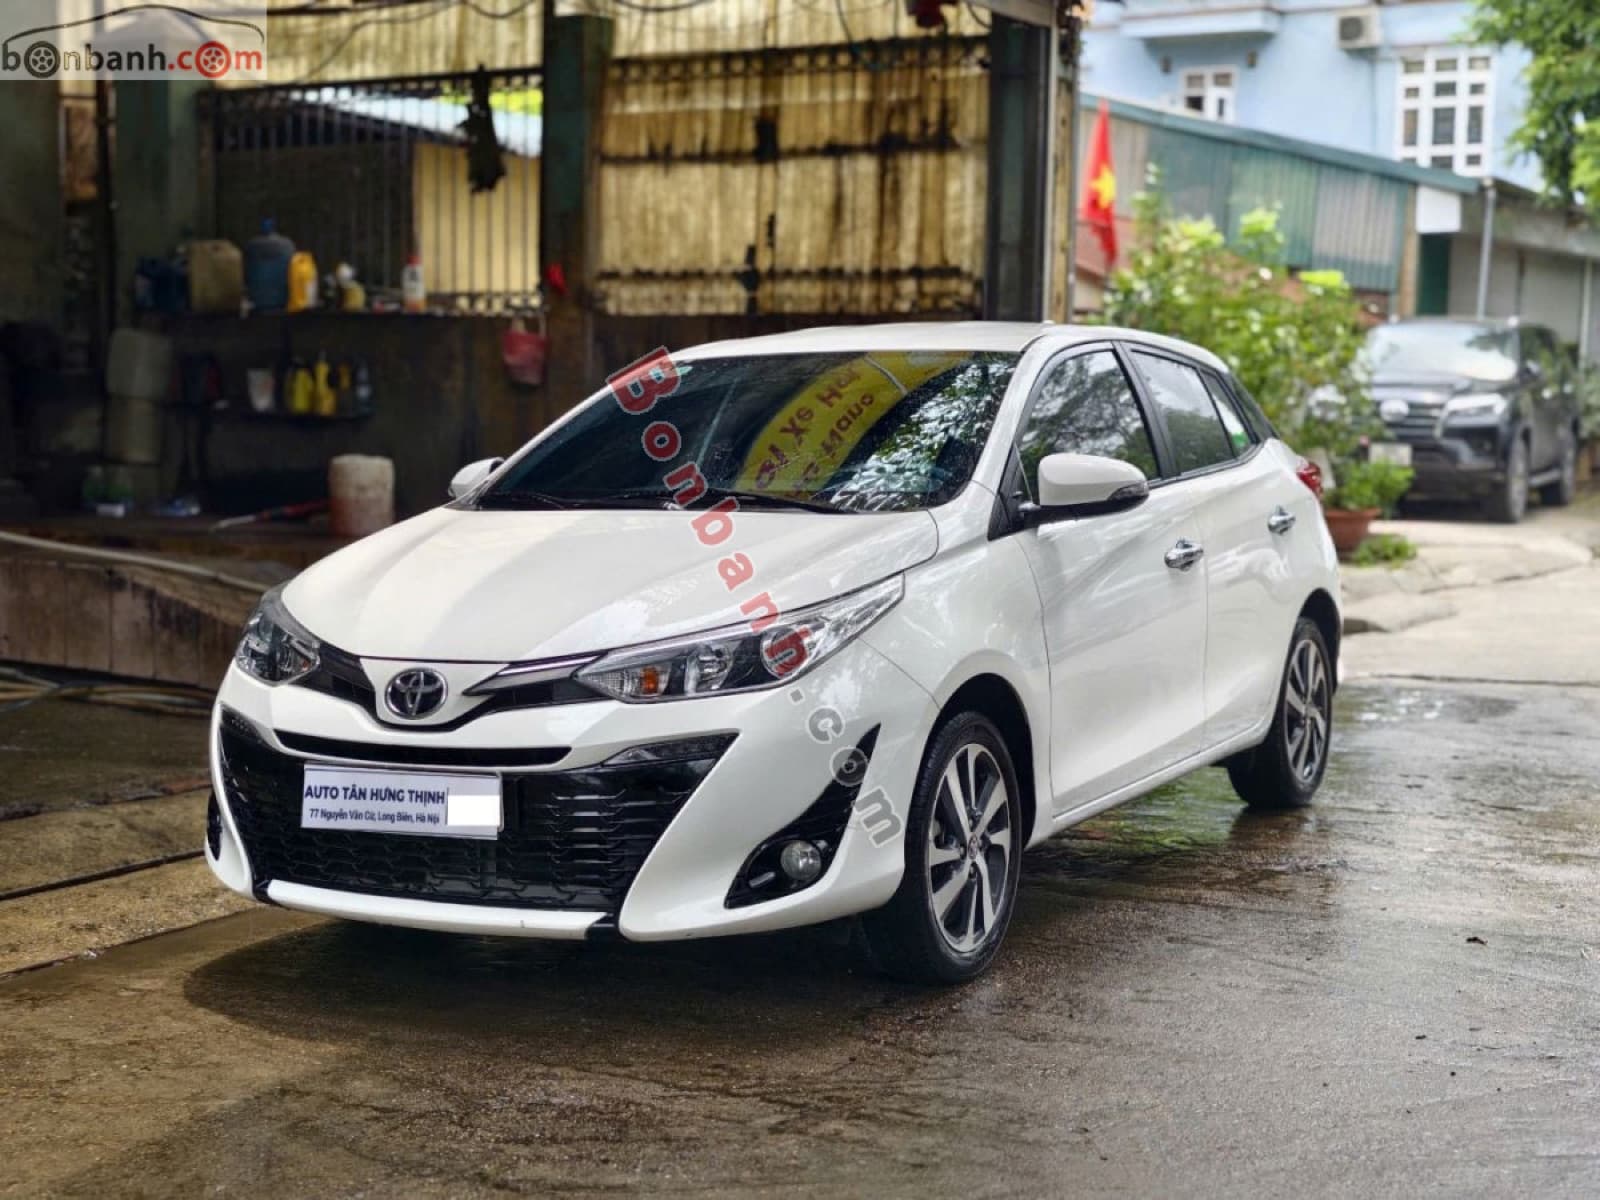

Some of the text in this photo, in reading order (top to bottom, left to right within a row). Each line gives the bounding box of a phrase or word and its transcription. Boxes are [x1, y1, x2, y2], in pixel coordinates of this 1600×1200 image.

[304, 783, 445, 807] AUTO TÂN HƯNG THỊNH
[309, 808, 320, 818] 77
[378, 811, 395, 824] Long
